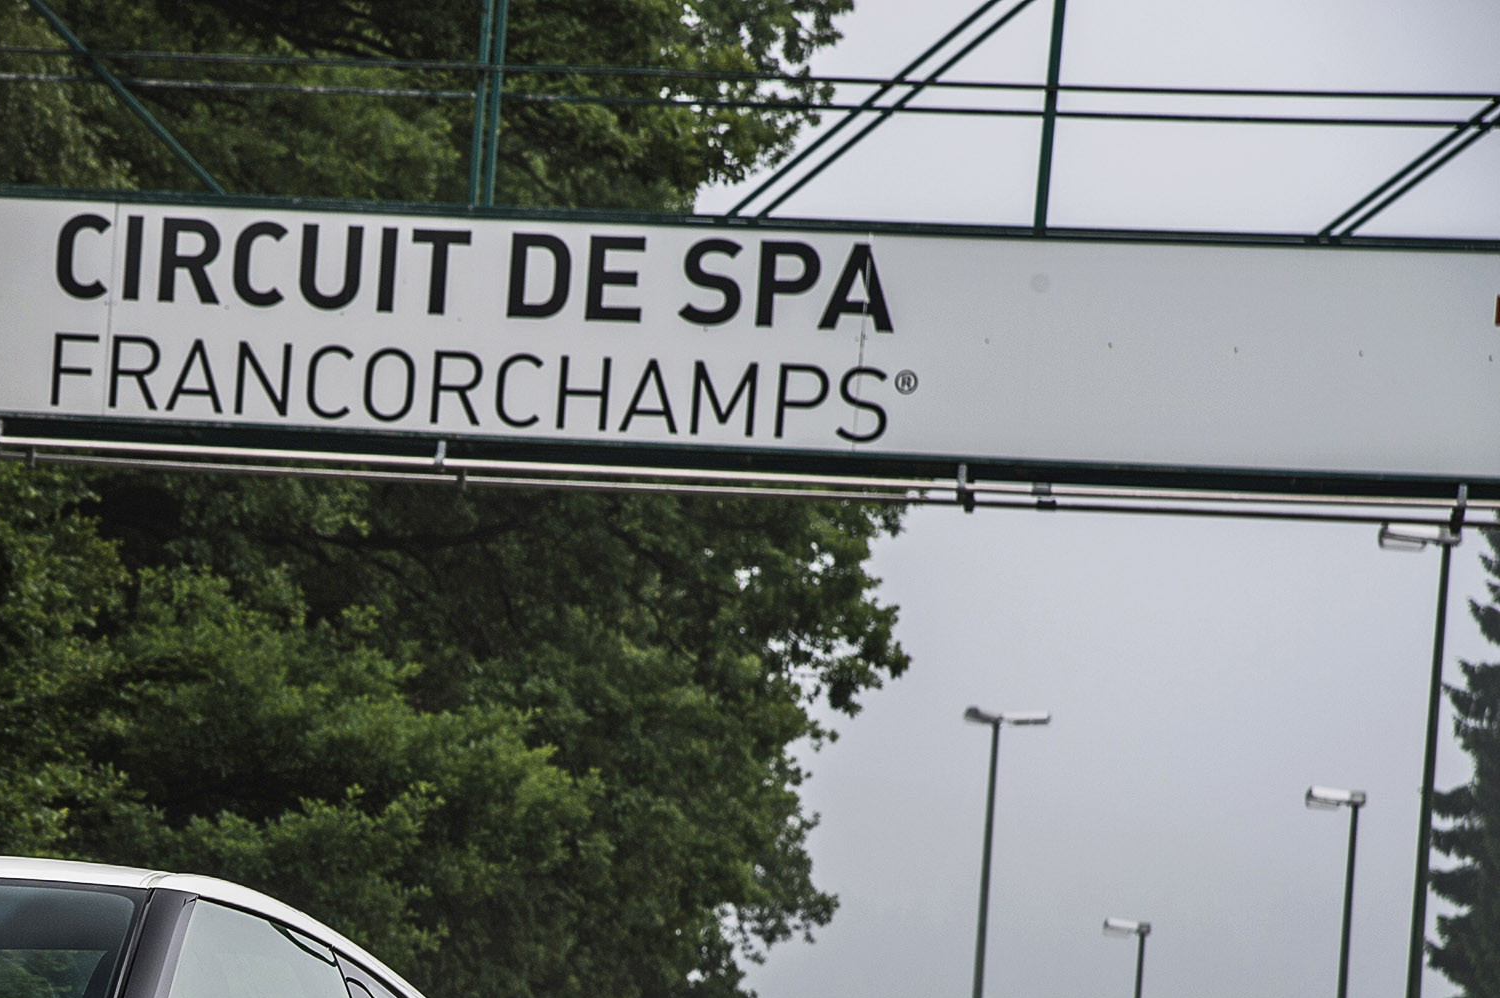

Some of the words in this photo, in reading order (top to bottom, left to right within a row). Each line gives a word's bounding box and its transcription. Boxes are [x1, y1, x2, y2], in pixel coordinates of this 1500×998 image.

[56, 213, 472, 316] CIRCUIT
[506, 232, 647, 323] DE
[678, 238, 894, 334] SPA
